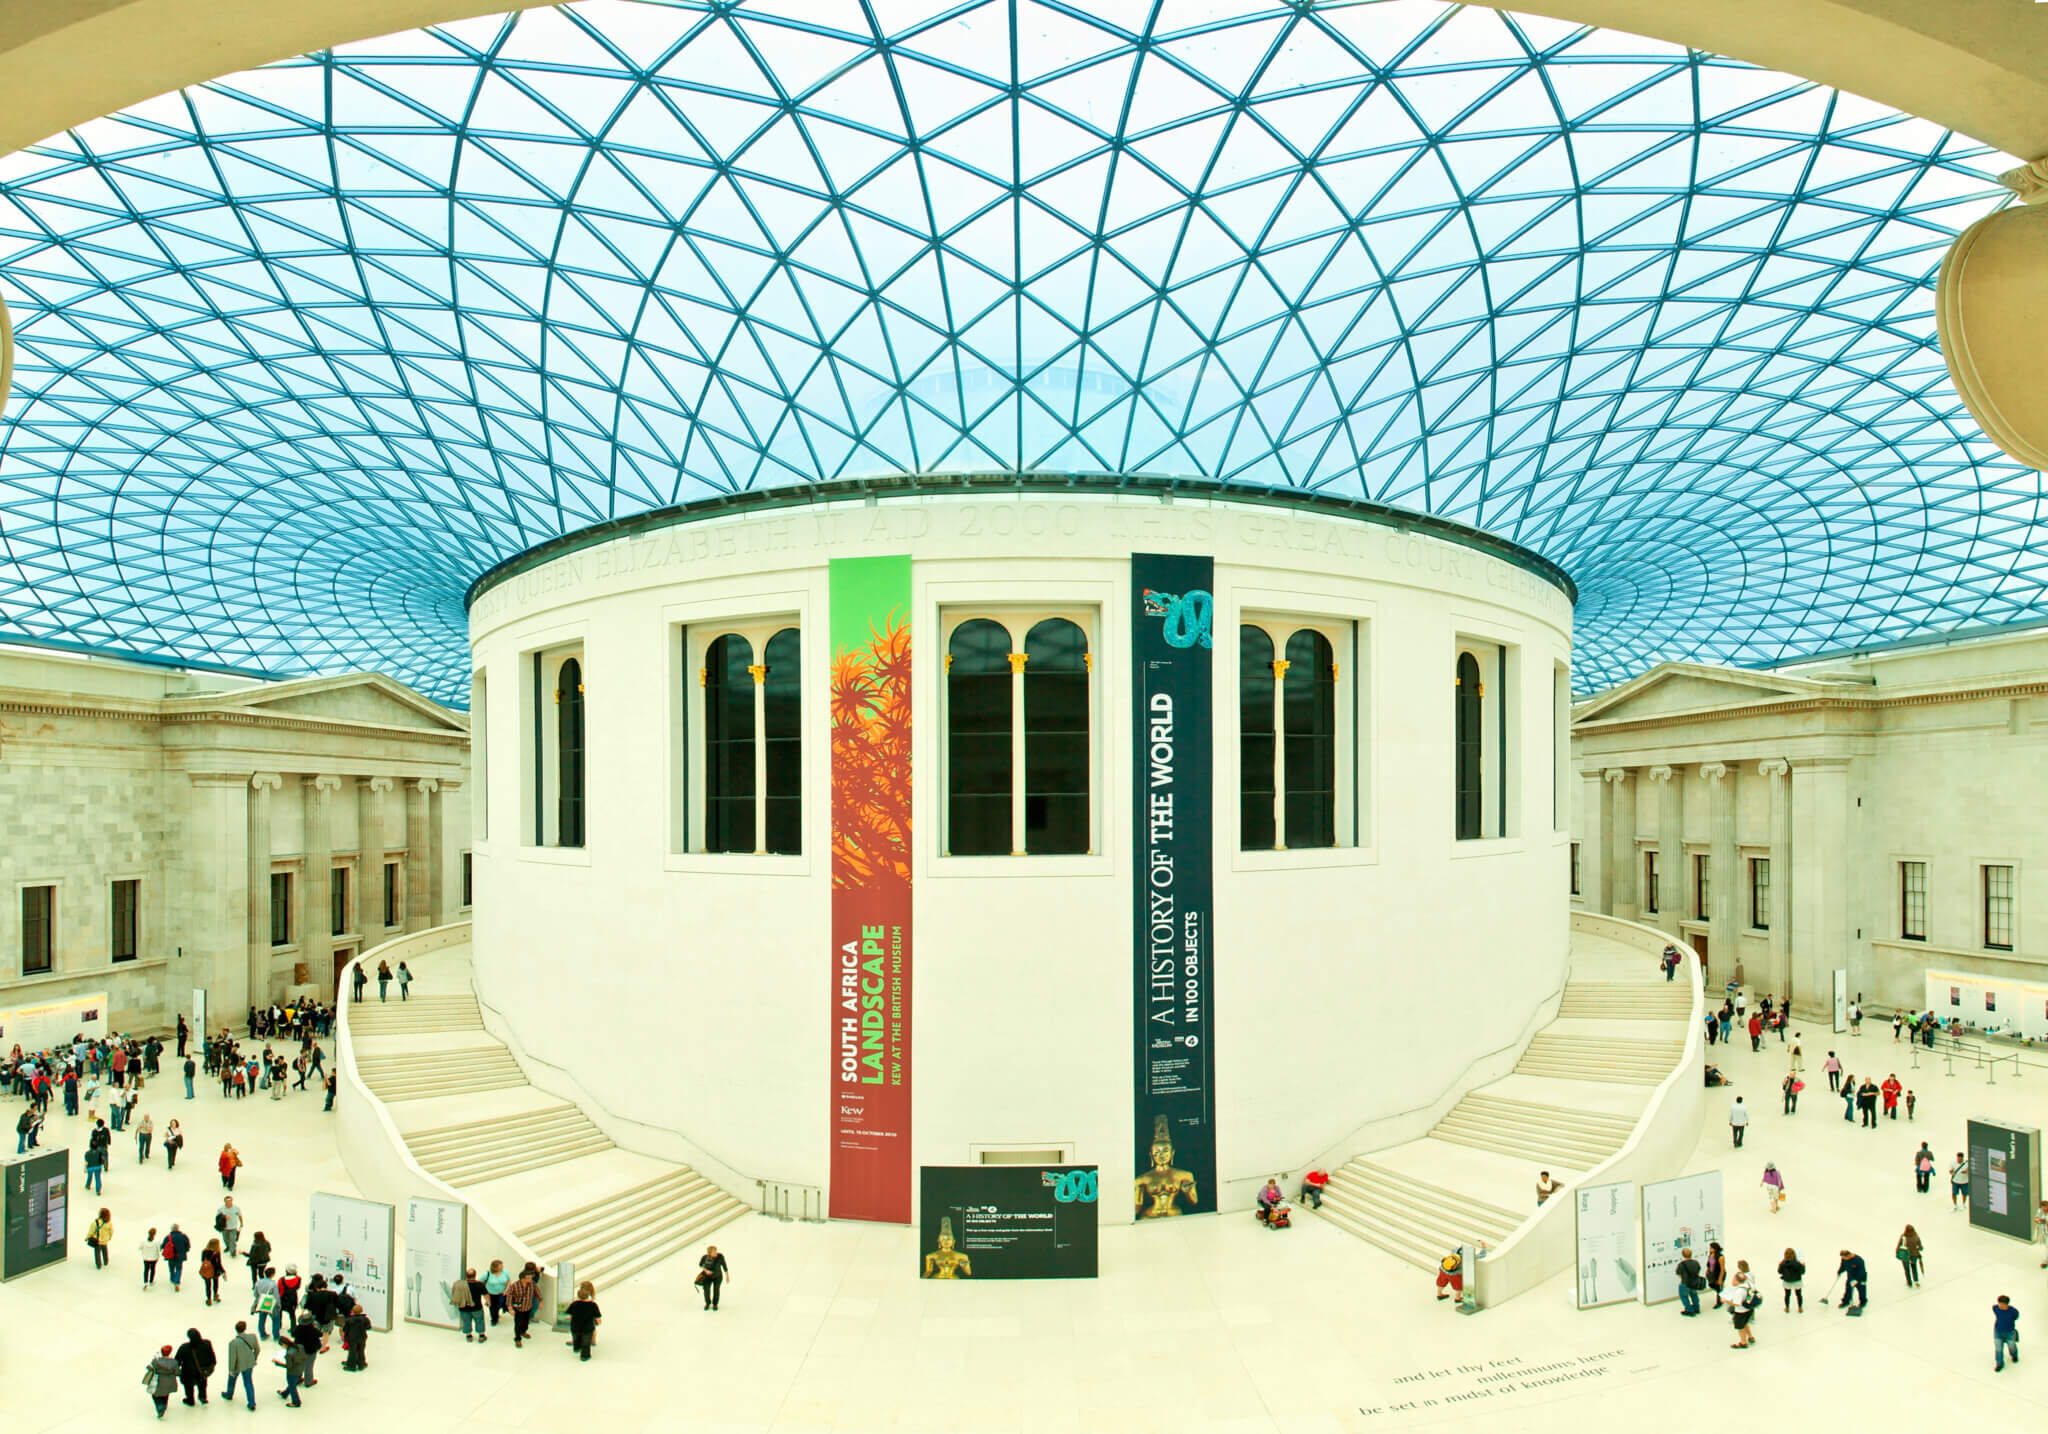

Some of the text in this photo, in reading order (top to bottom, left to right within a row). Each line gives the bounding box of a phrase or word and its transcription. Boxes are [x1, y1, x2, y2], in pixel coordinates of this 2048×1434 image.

[517, 556, 584, 603] QUEEN
[594, 517, 796, 579] ELIZABETH
[959, 503, 1081, 537] 2000
[1104, 506, 1212, 542] THIS
[1237, 514, 1368, 559] GREAT
[1385, 535, 1476, 581] COURT
[1150, 693, 1174, 788] WORLD
[1151, 793, 1173, 844] THE
[1151, 848, 1174, 888] OF
[842, 941, 858, 1012] AFRICA
[1151, 892, 1175, 1005] HISTORY
[1185, 911, 1198, 1023] IN 100 OBJECTS
[862, 925, 885, 1085] LANDSCAPE
[892, 925, 902, 1086] KEW AT THE BRITISH MUSEUM
[1151, 1007, 1175, 1025] A
[842, 1018, 858, 1083] SOUTH
[1359, 1364, 1610, 1417] be set in midst of knowledge
[1393, 1356, 1525, 1385] and let thy feet
[1477, 1347, 1627, 1385] millenniums hence
